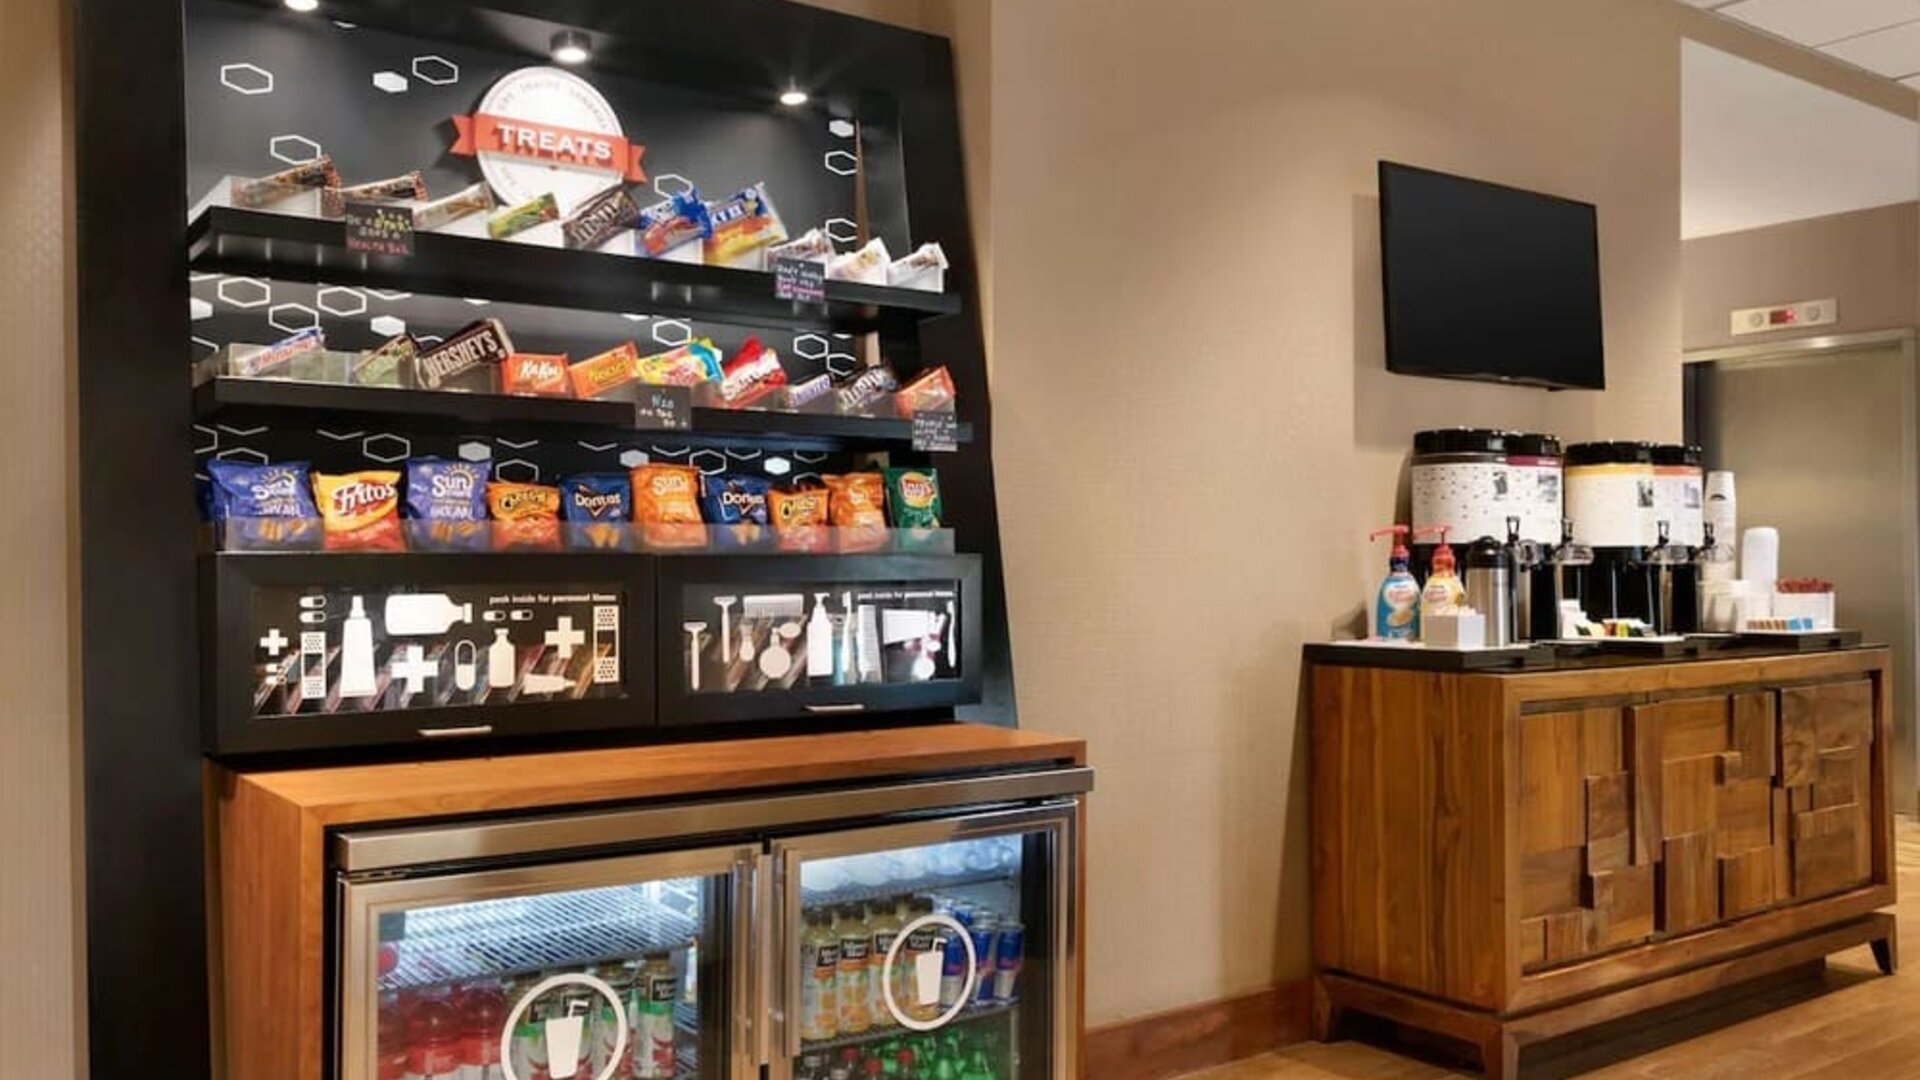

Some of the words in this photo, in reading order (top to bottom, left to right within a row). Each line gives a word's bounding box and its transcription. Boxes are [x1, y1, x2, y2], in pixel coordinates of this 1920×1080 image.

[497, 124, 612, 160] TREATS
[422, 330, 498, 378] HERSHEY'S
[332, 482, 396, 516] Fritos
[431, 474, 473, 498] Sun
